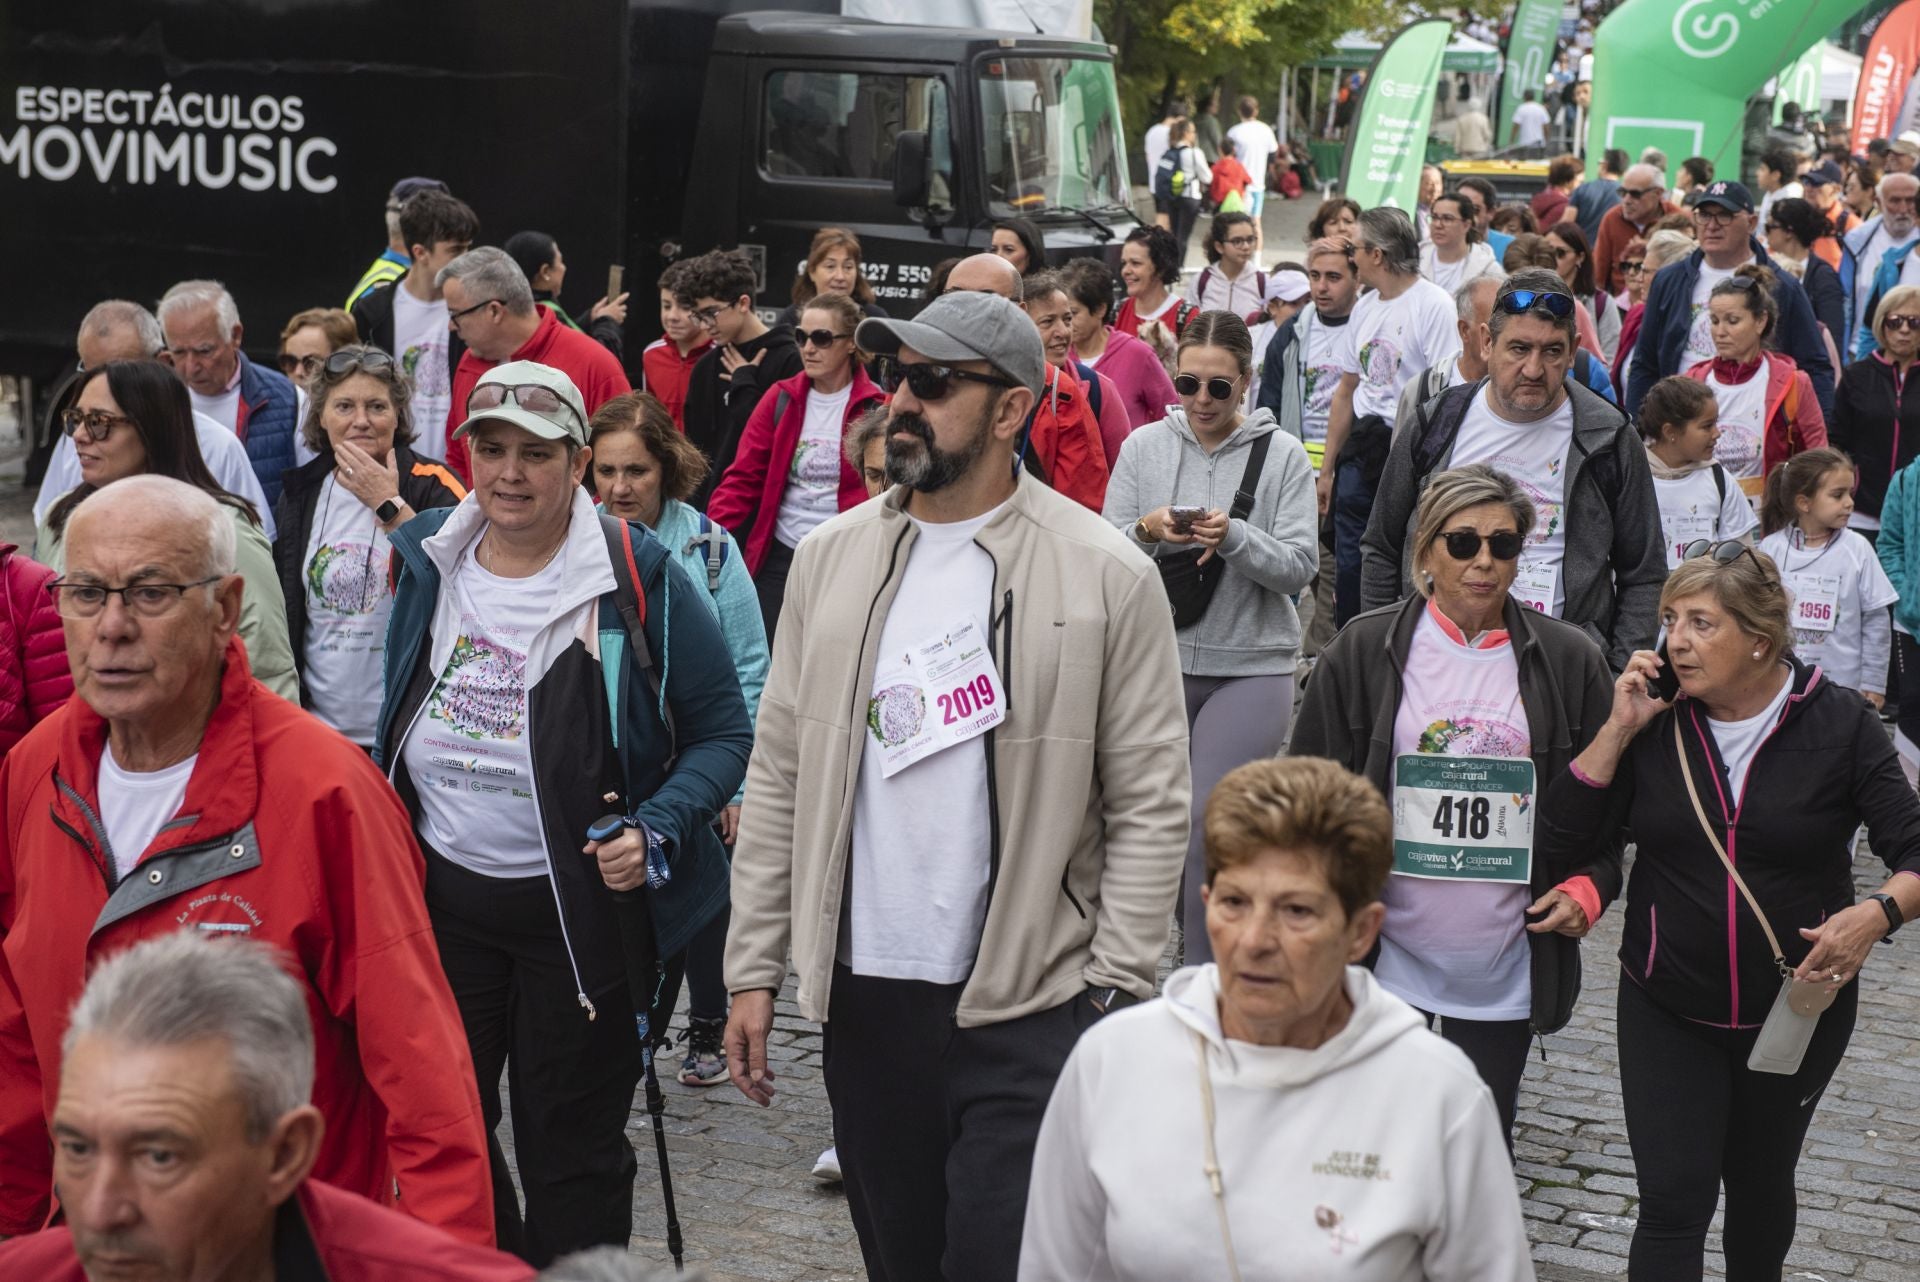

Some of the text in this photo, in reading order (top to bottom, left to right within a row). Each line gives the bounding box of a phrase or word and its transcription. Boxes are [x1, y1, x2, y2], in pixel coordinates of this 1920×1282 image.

[16, 82, 305, 132] ESPECTÁCULOS
[0, 124, 338, 194] MOVIMUSIC
[898, 264, 932, 283] 550
[1798, 601, 1832, 620] 1956
[936, 674, 996, 726] 2019
[955, 708, 1000, 737] cajarural
[423, 738, 450, 750] CONTRA
[451, 743, 460, 751] EL
[461, 744, 489, 755] CÁNCER
[432, 755, 464, 769] cajaviva
[478, 762, 516, 776] cajarural
[1441, 770, 1487, 782] cajarural
[1470, 780, 1504, 791] CÁNCER
[1432, 795, 1491, 840] 418
[1407, 851, 1513, 867] cajaviva cajarural
[176, 911, 189, 924] La
[220, 892, 232, 903] de
[233, 895, 263, 927] Calidad
